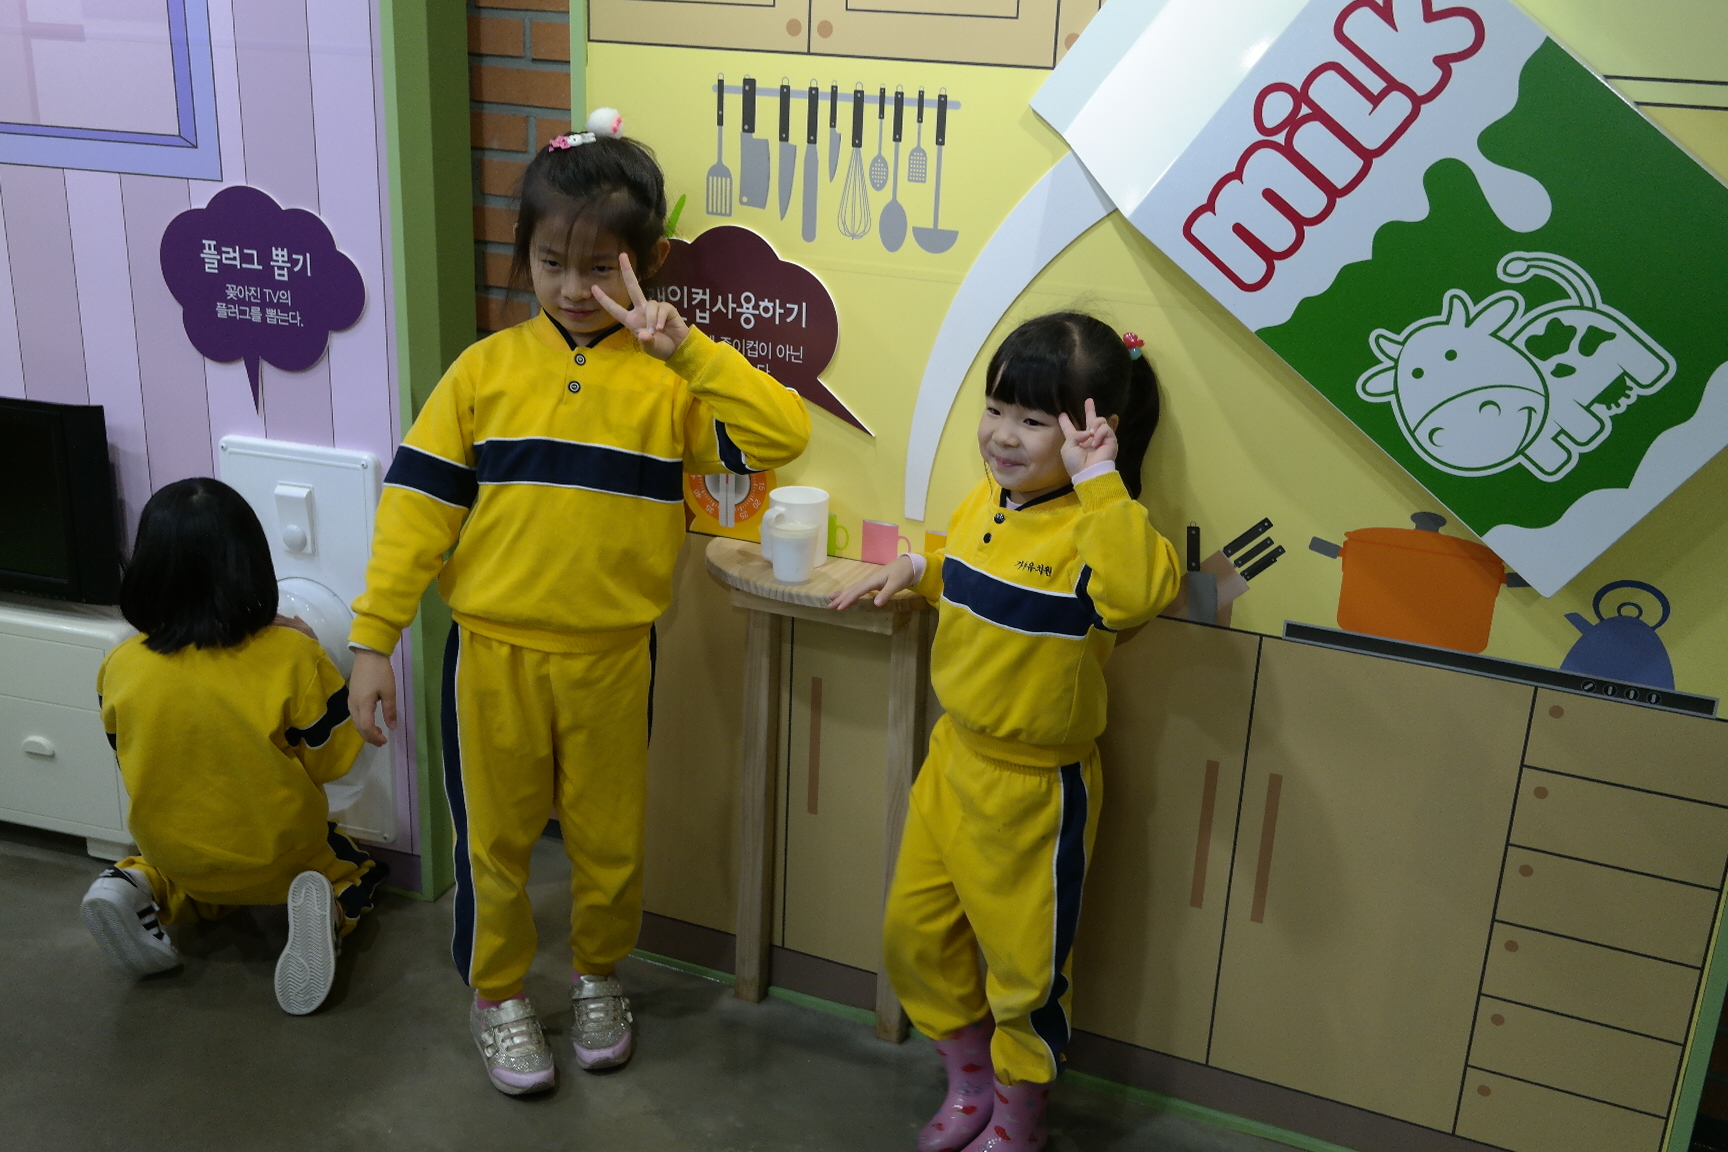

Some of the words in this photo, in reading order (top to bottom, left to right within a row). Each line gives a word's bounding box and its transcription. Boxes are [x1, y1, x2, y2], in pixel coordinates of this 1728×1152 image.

[200, 239, 263, 274] 플러그
[269, 246, 312, 281] 뽑기
[225, 283, 261, 303] 꽂아진
[263, 288, 292, 306] TV의
[215, 302, 262, 323] 플러그를
[265, 307, 304, 327] 뽑는다.
[776, 343, 804, 364] 아닌
[752, 498, 762, 509] 20
